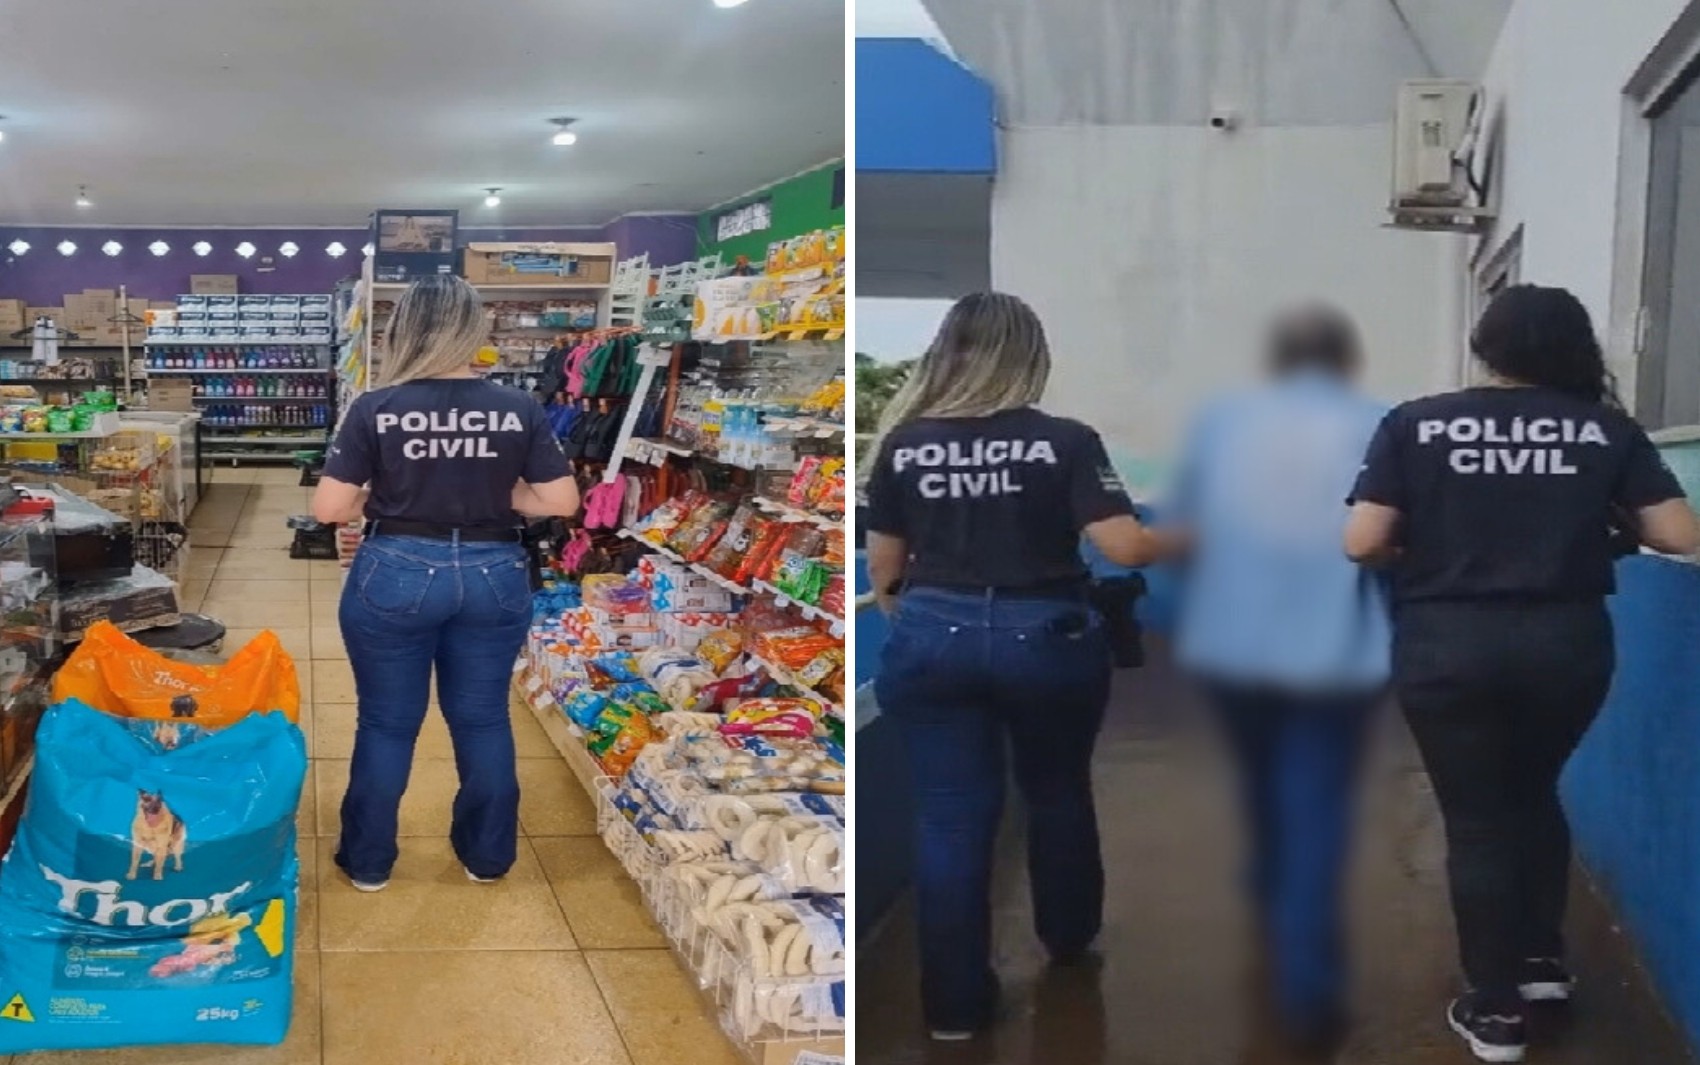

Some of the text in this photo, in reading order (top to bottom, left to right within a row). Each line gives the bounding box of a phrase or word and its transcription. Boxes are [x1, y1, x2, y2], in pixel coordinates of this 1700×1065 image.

[376, 408, 524, 434] POLÍCIA
[1418, 416, 1609, 445] POLÍCIA
[403, 437, 499, 460] CIVIL
[893, 438, 1057, 473] POLÍCIA
[1449, 449, 1578, 475] CIVIL
[918, 470, 1022, 498] CIVIL
[39, 863, 252, 926] Thor
[11, 1002, 24, 1017] T
[195, 1006, 240, 1021] 25kg
